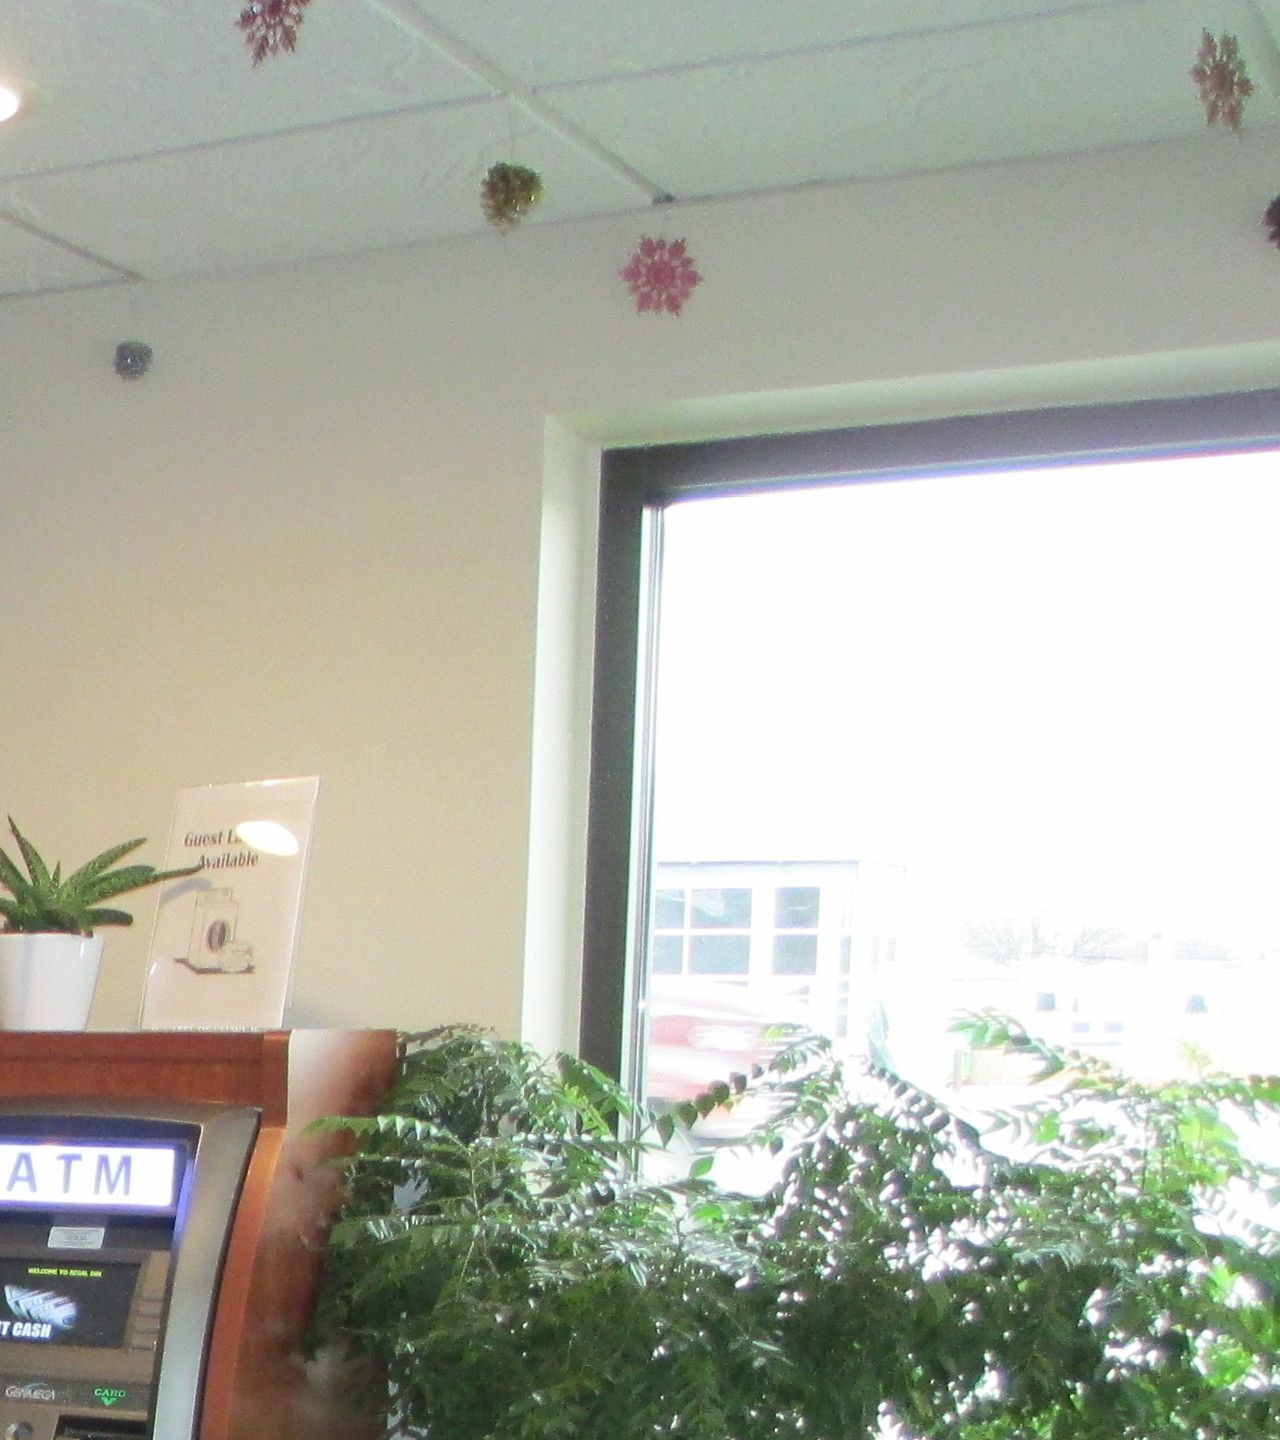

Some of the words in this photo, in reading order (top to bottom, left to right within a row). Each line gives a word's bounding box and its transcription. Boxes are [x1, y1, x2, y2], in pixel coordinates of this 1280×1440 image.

[184, 829, 223, 848] Guest
[197, 851, 259, 869] Available
[6, 1151, 133, 1196] ATM
[28, 1267, 58, 1276] WELCOME
[59, 1268, 69, 1276] TO
[11, 1321, 53, 1339] CASH
[94, 1388, 126, 1398] CARD
